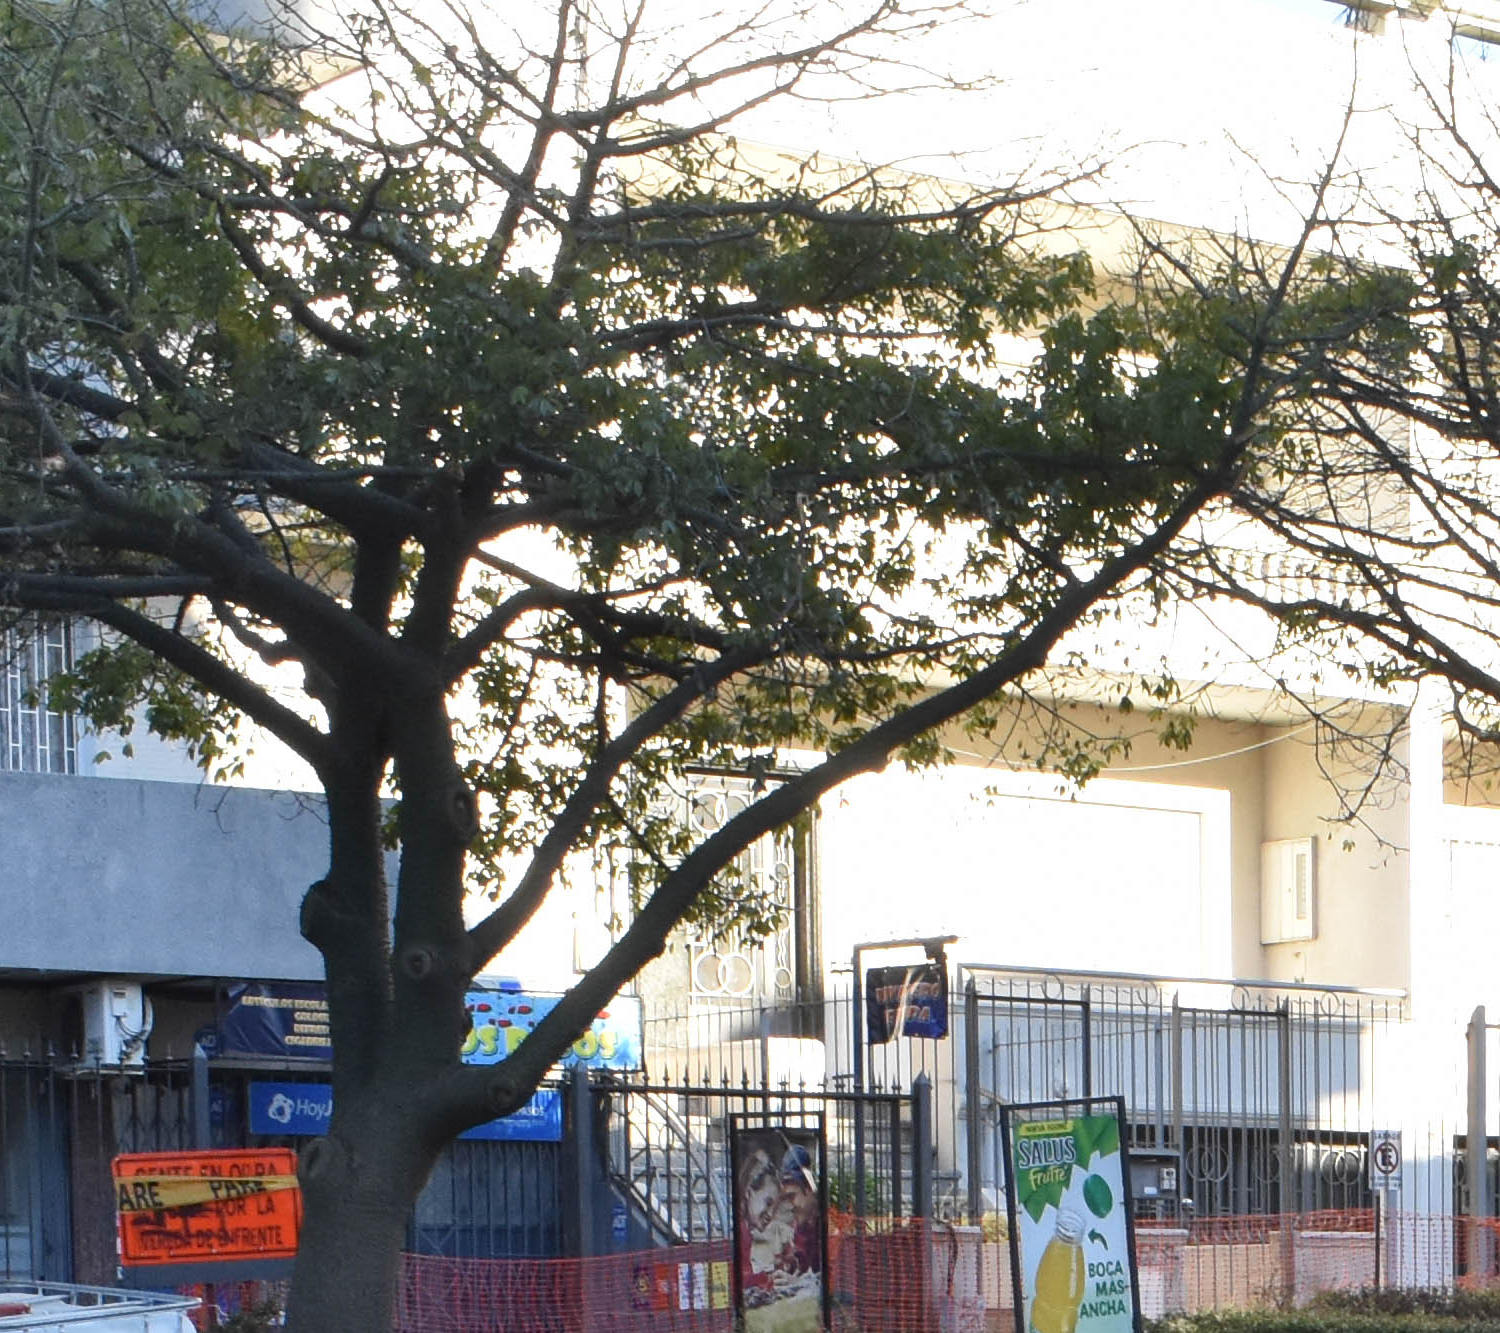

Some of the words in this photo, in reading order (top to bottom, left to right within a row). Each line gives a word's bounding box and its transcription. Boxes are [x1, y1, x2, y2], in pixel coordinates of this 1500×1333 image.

[1019, 1136, 1076, 1168] SALUS
[257, 1196, 276, 1214] LA
[1088, 1261, 1123, 1278] BOCA
[1080, 1299, 1127, 1318] ANCHA
